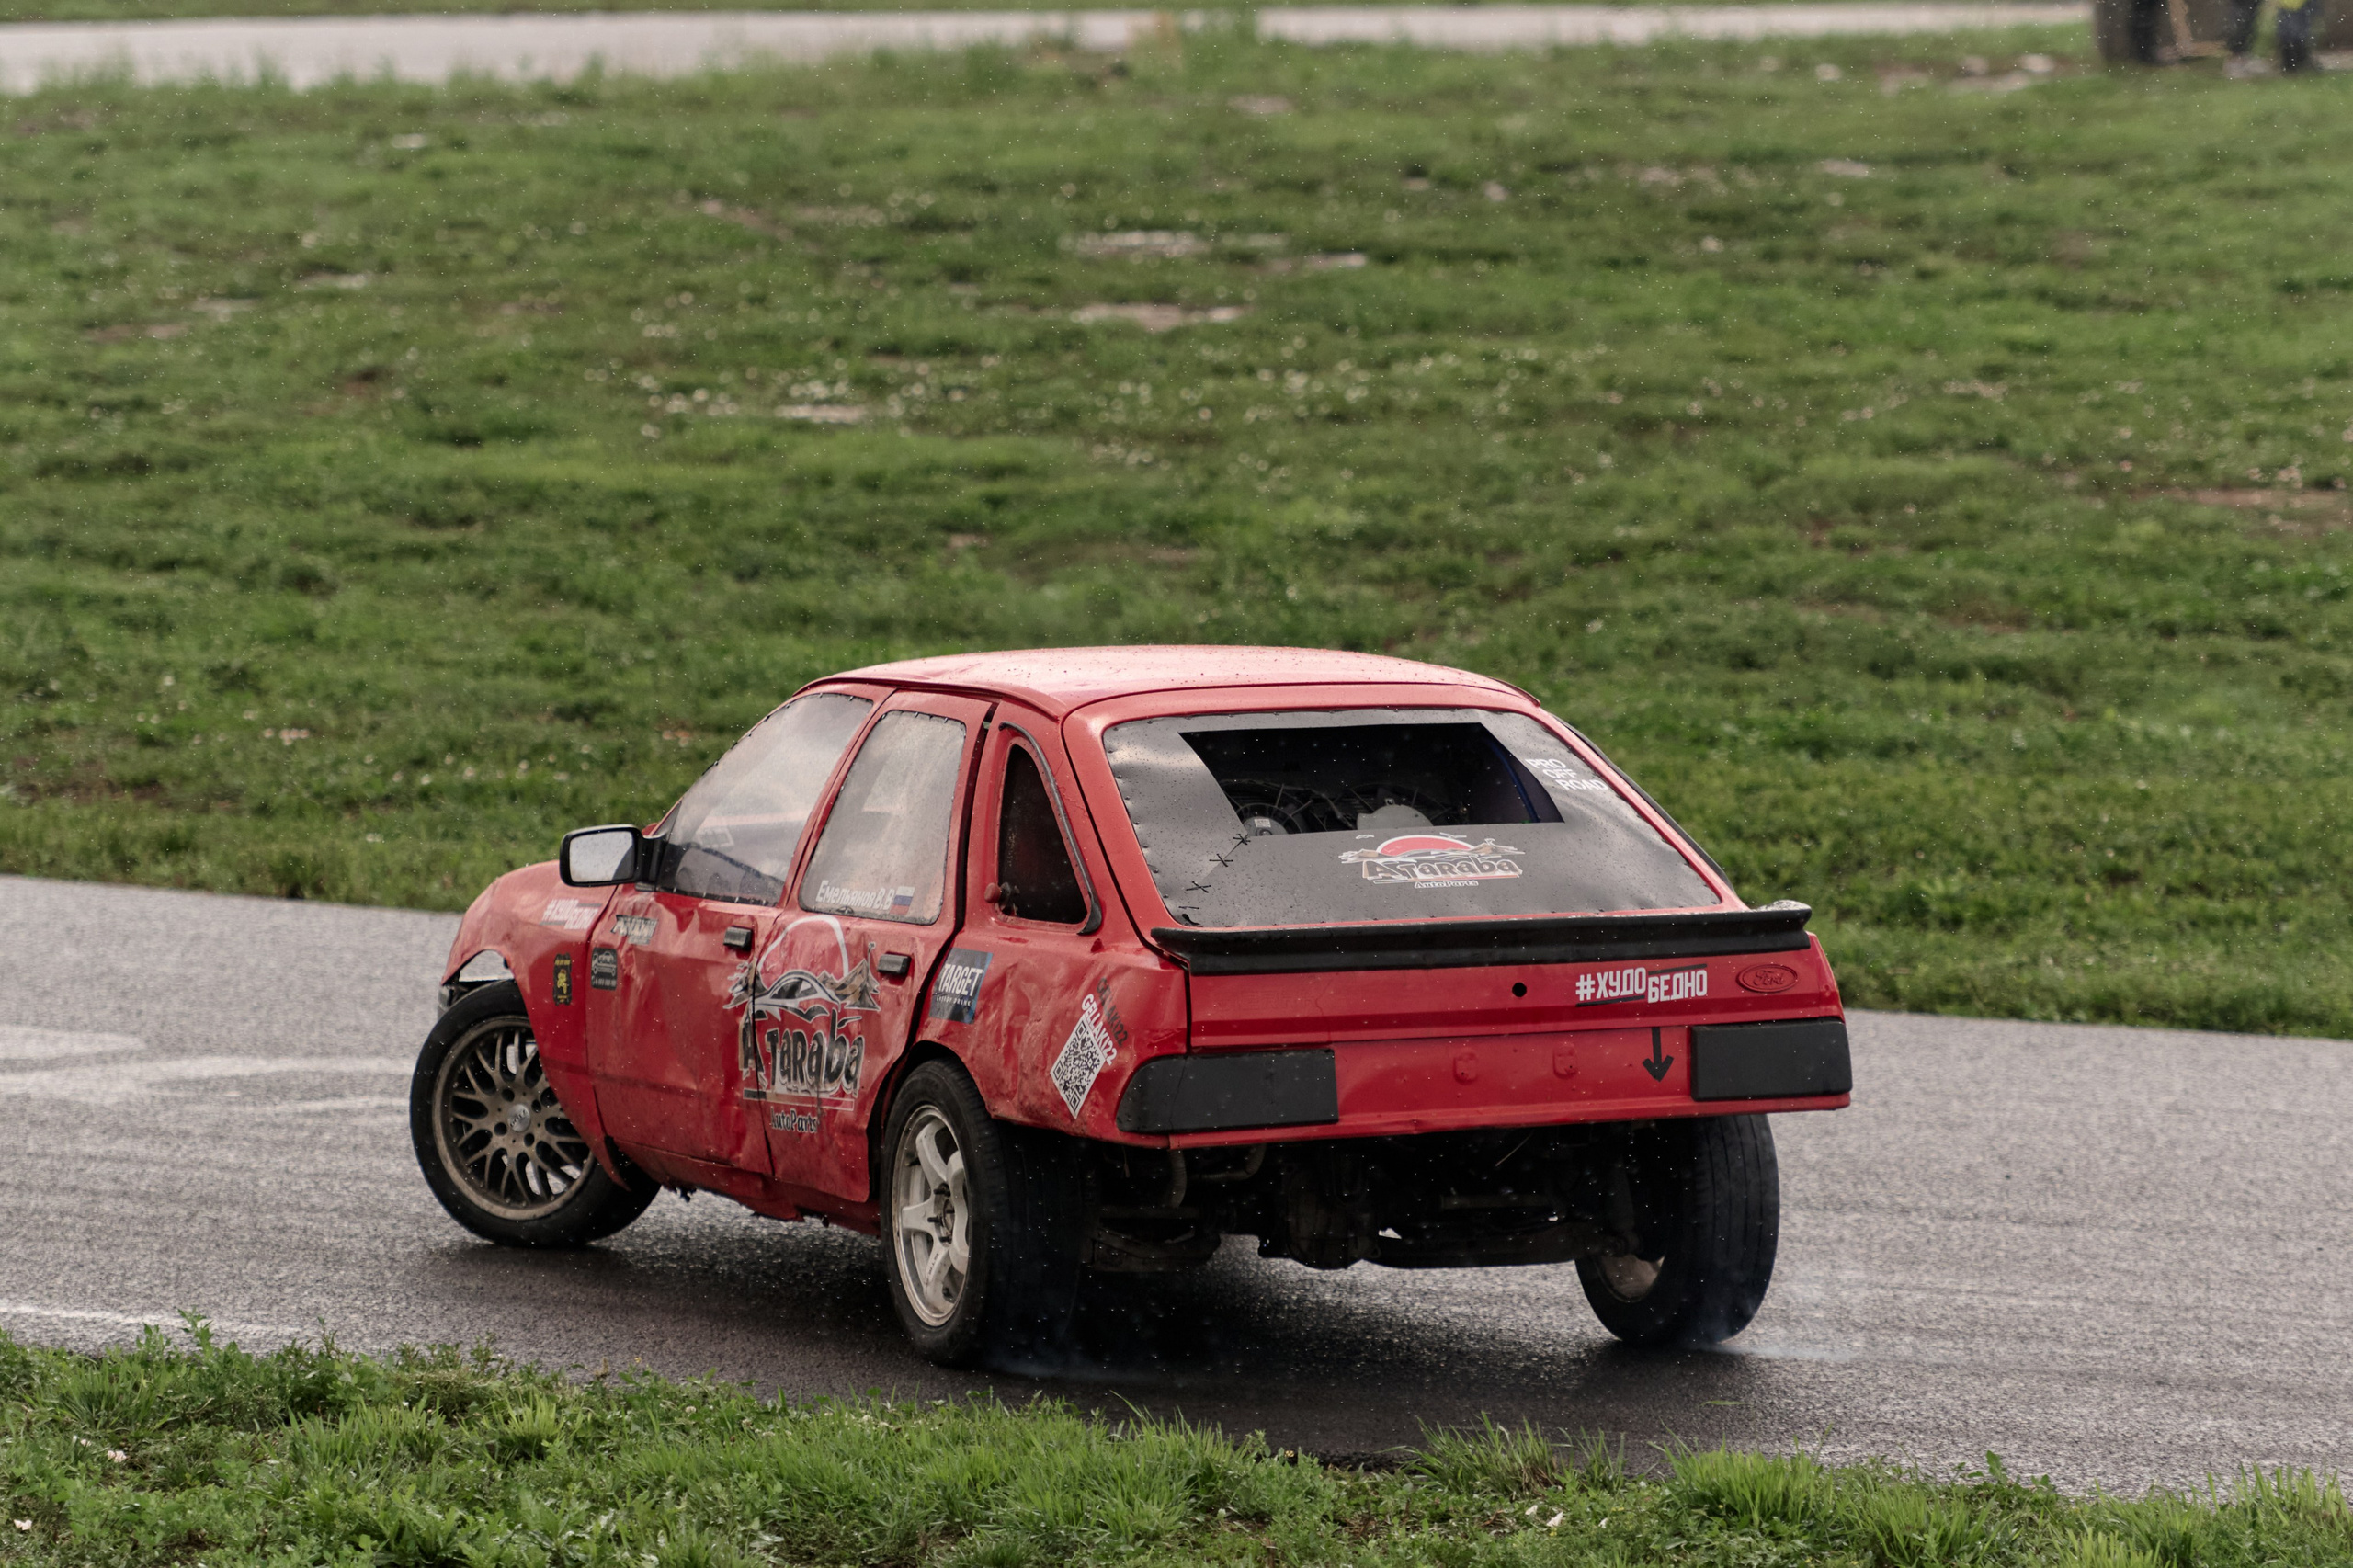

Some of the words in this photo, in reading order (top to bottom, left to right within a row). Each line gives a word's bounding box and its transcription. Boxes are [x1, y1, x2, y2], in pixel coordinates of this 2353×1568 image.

[1524, 758, 1566, 769] PRO
[1542, 768, 1577, 779] OFF
[1555, 779, 1609, 790] ROAD
[1414, 880, 1480, 890] AutoParts
[938, 963, 983, 997] TARGET
[1752, 969, 1785, 987] Ford
[953, 997, 972, 1007] DRINK
[770, 1106, 818, 1133] AutoParts
